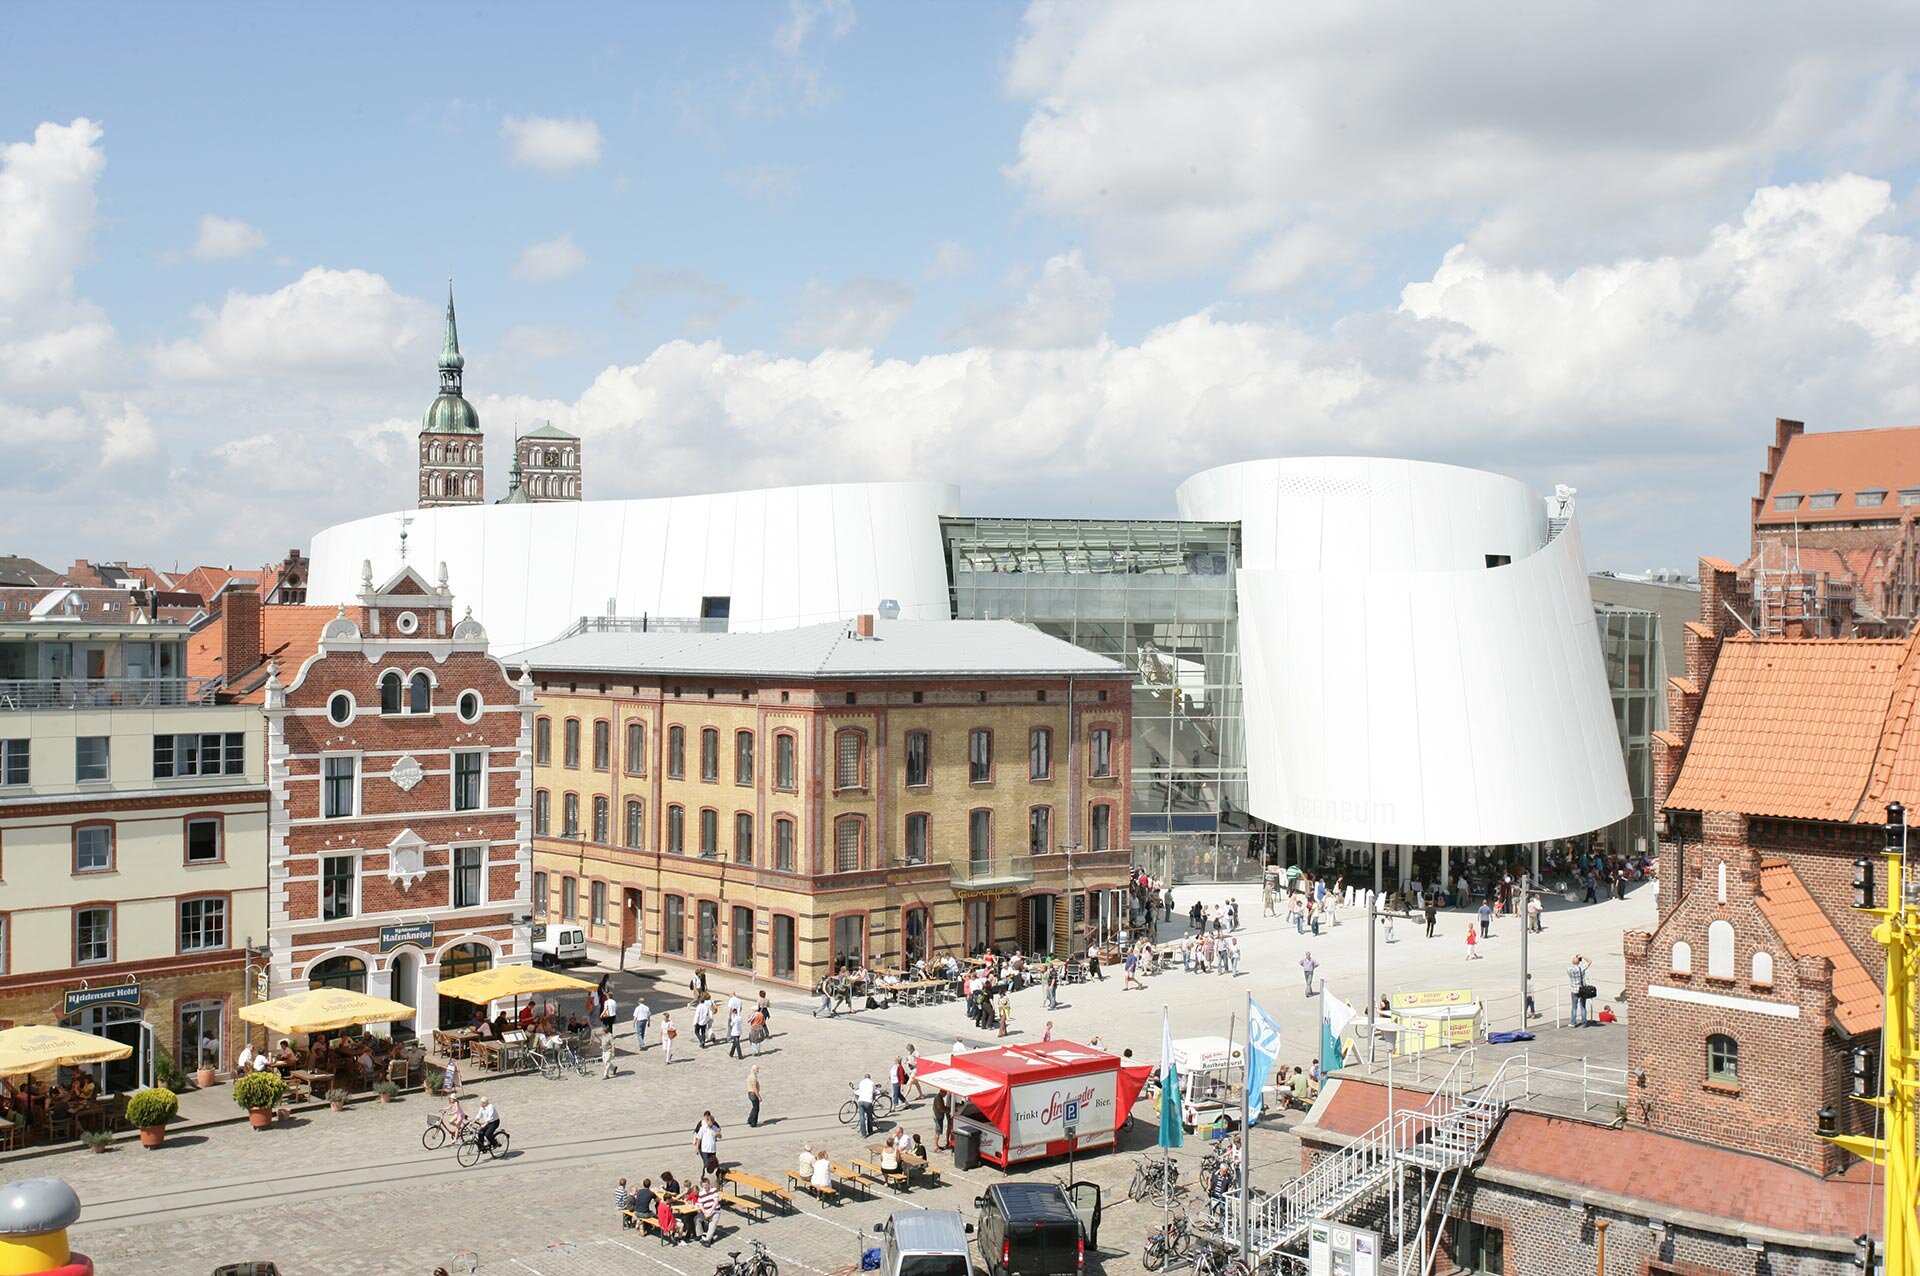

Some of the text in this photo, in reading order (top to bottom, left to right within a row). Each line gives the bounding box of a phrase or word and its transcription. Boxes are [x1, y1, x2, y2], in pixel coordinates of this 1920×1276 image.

[382, 931, 432, 942] Hafenkneipe
[117, 987, 138, 997] Hotel
[1015, 1110, 1039, 1121] Trinkt
[1095, 1097, 1111, 1108] Bier.
[1068, 1105, 1075, 1119] P
